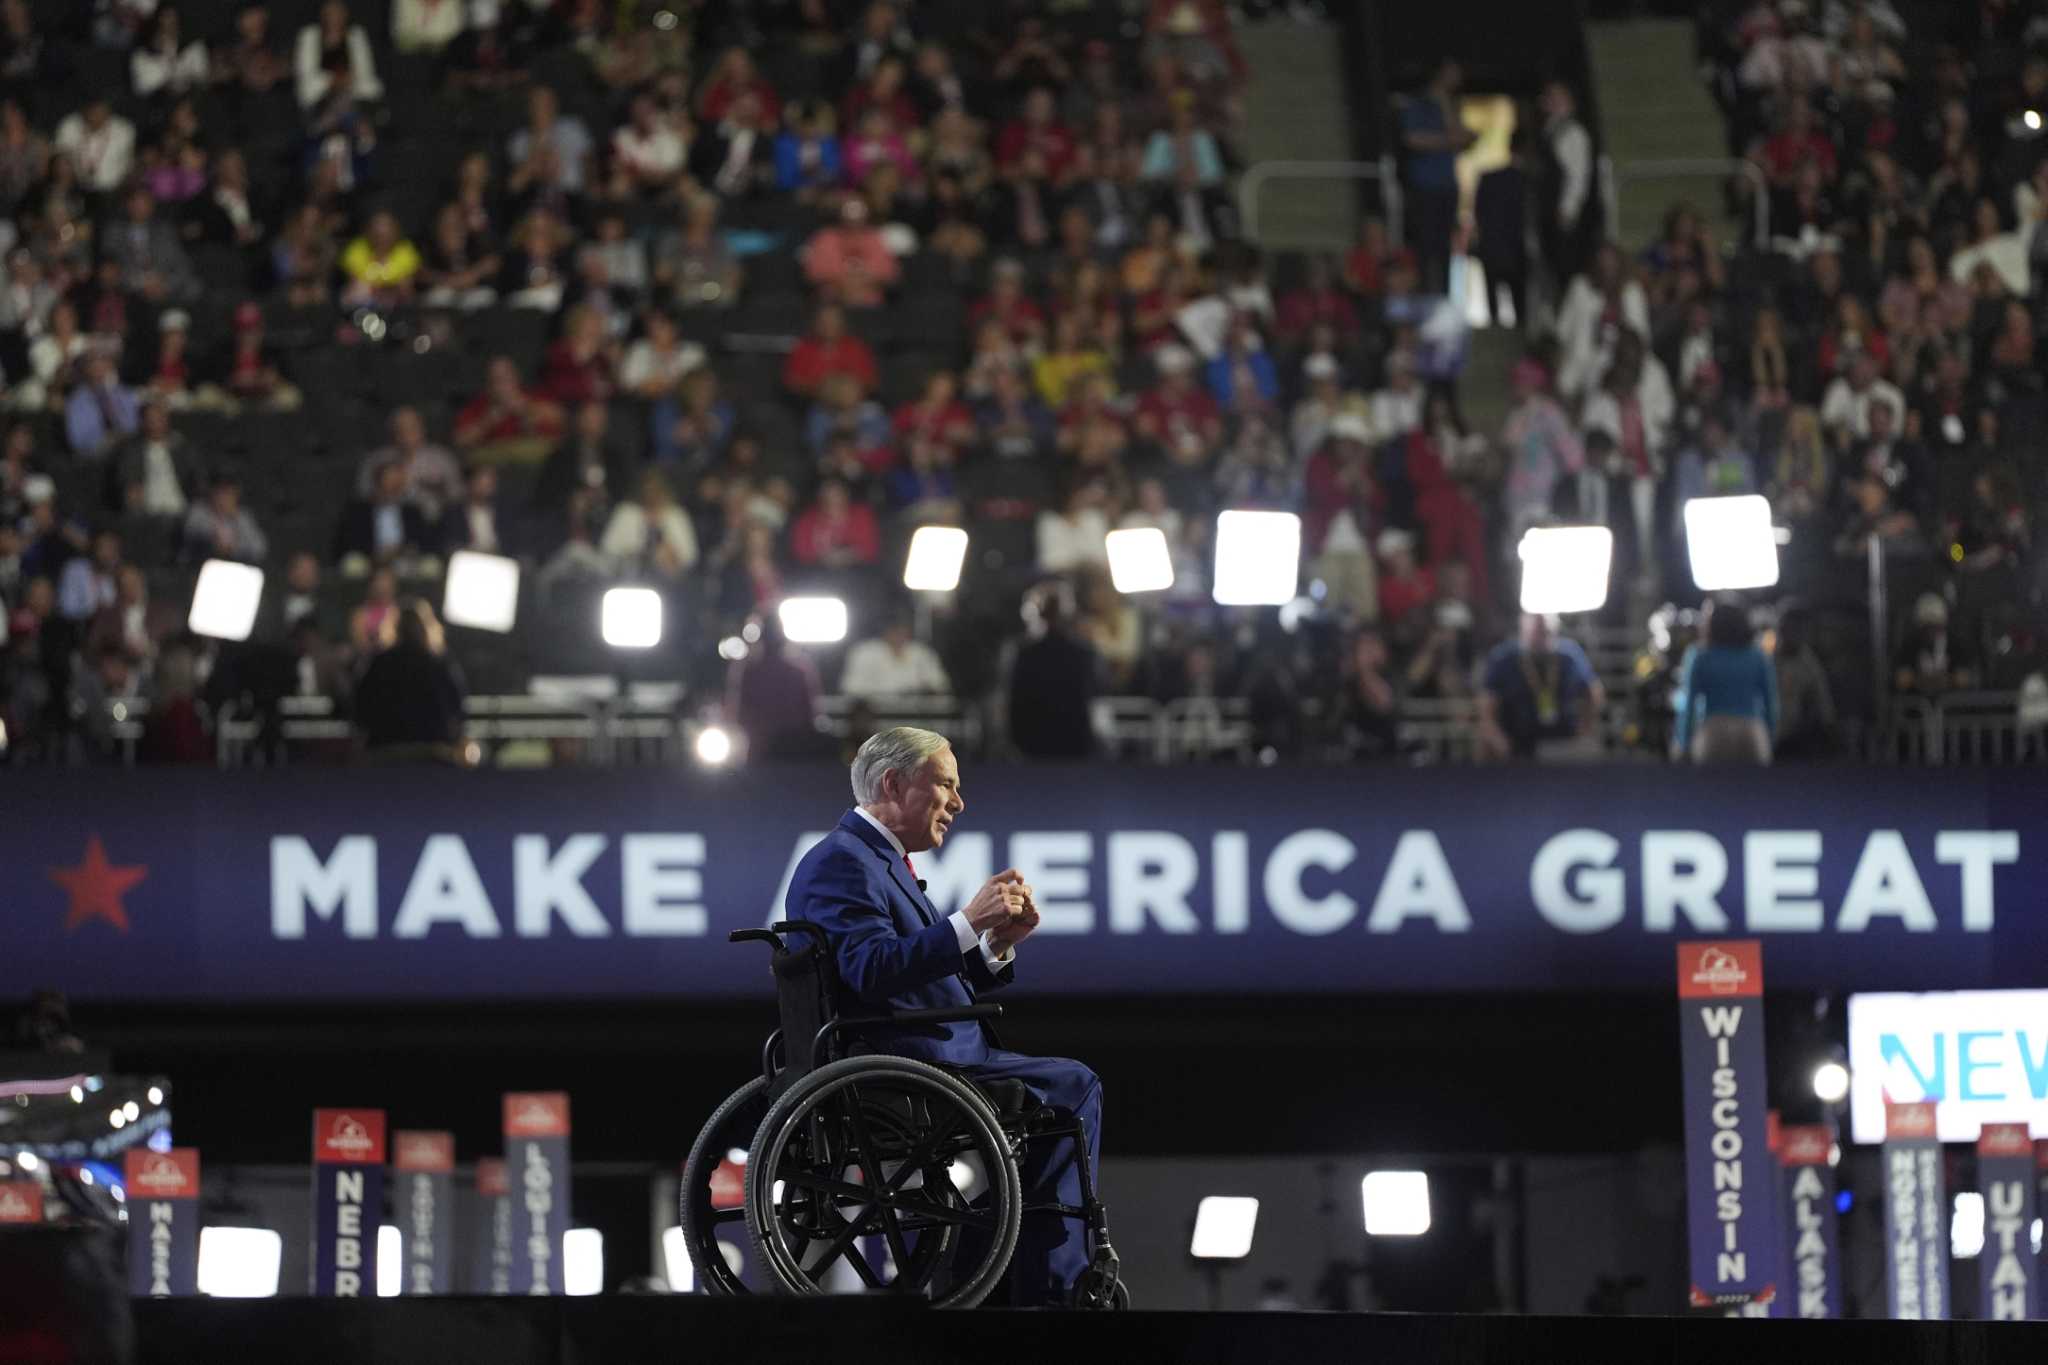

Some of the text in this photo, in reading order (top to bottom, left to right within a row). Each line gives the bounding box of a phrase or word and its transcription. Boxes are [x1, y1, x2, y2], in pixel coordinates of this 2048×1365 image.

[270, 828, 2020, 939] MAKE MERICA GREAT
[1701, 1006, 1746, 1283] WISCONSIN
[335, 1170, 364, 1297] NEBR
[1989, 1181, 2026, 1320] UTAH
